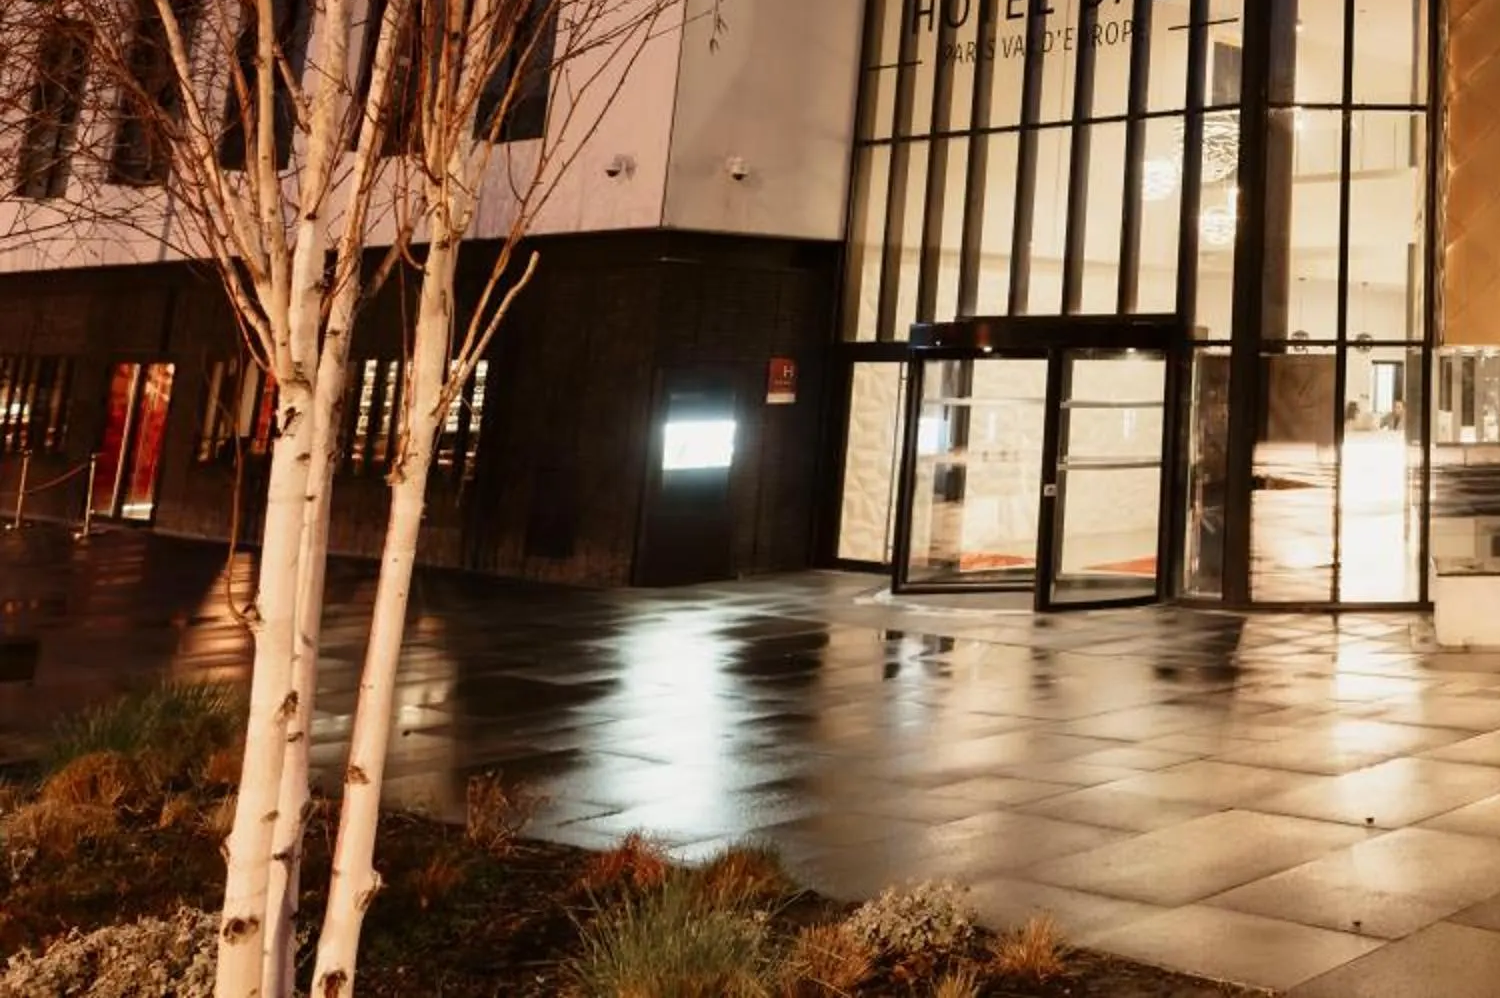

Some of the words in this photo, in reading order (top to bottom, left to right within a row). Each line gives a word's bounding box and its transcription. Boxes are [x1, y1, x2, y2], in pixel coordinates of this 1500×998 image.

[945, 36, 995, 64] PARS
[1002, 33, 1028, 59] VA
[1042, 19, 1143, 53] D'EROP
